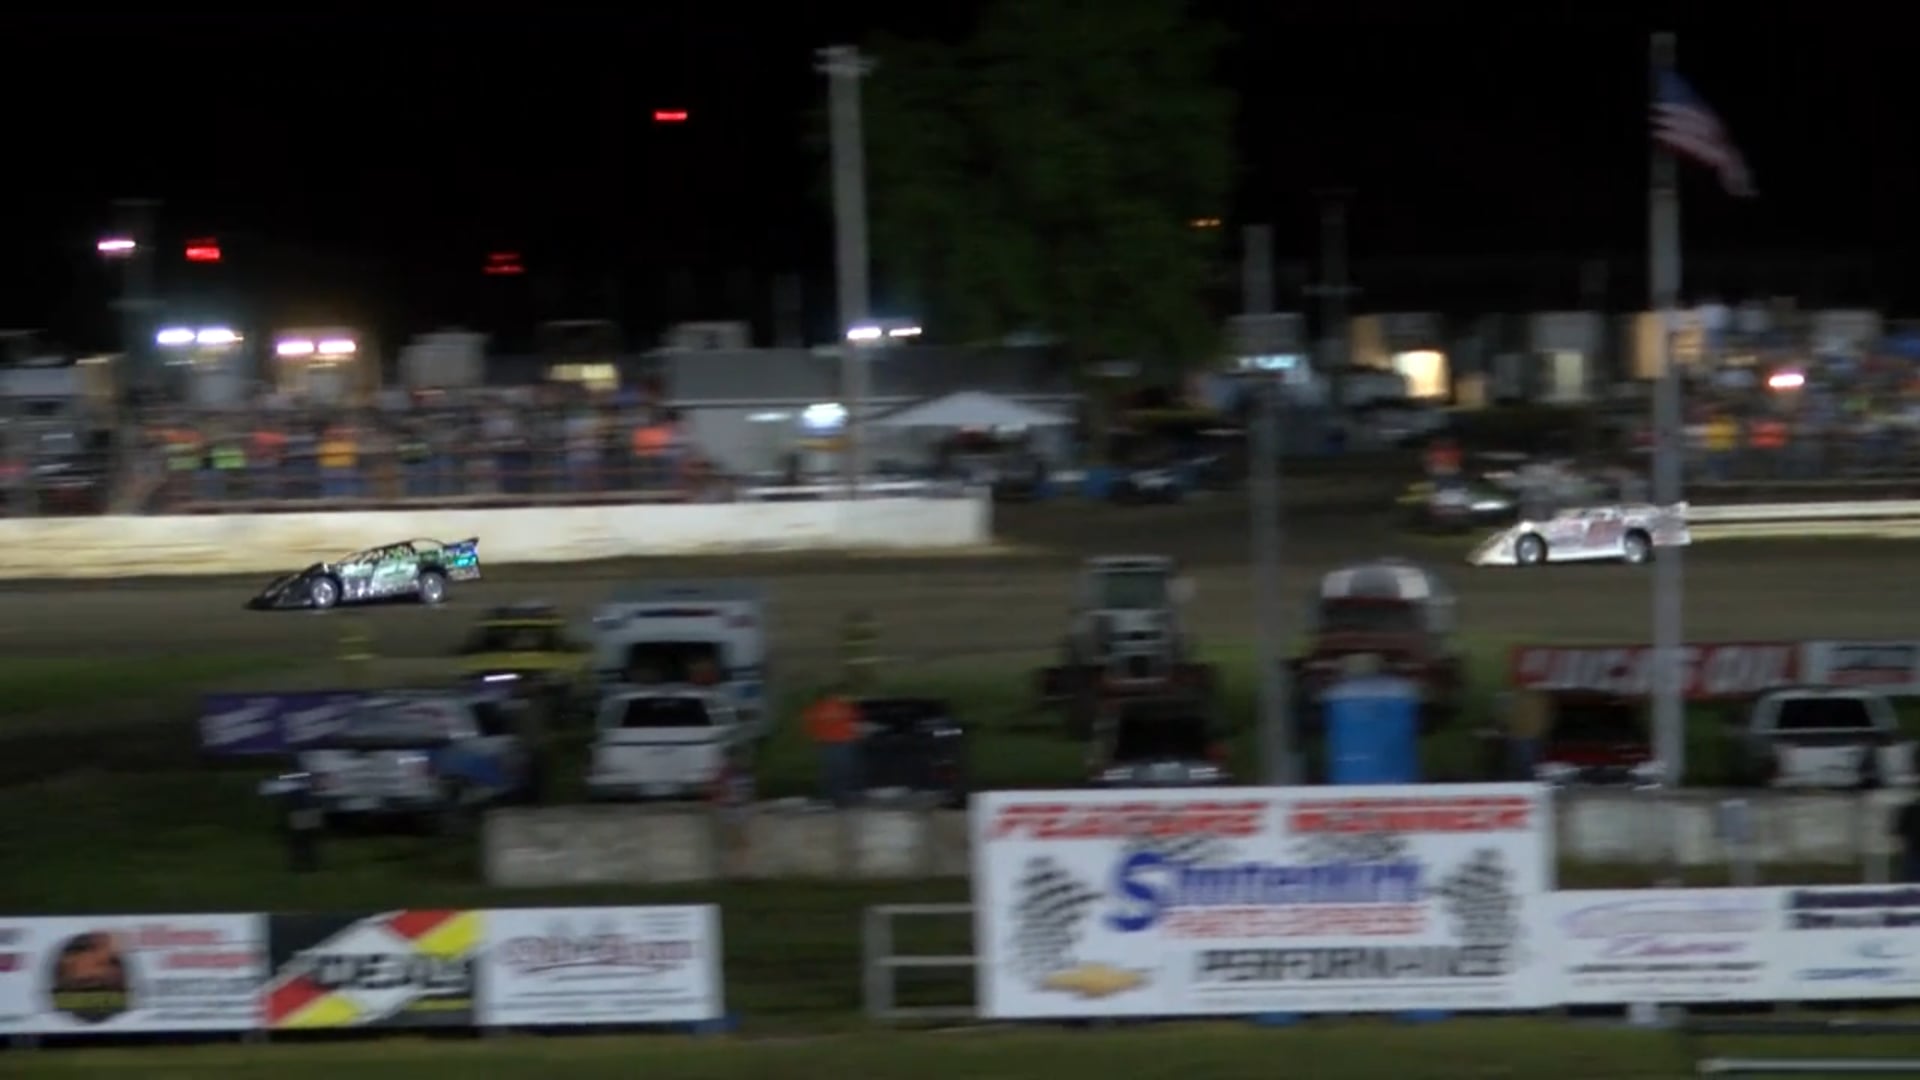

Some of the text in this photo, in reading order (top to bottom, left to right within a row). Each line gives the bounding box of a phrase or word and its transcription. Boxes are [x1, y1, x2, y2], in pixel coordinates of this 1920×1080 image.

[1706, 646, 1788, 693] OIL
[988, 797, 1531, 839] FEATURE WINNER
[1193, 945, 1509, 981] PERFORMANCE
